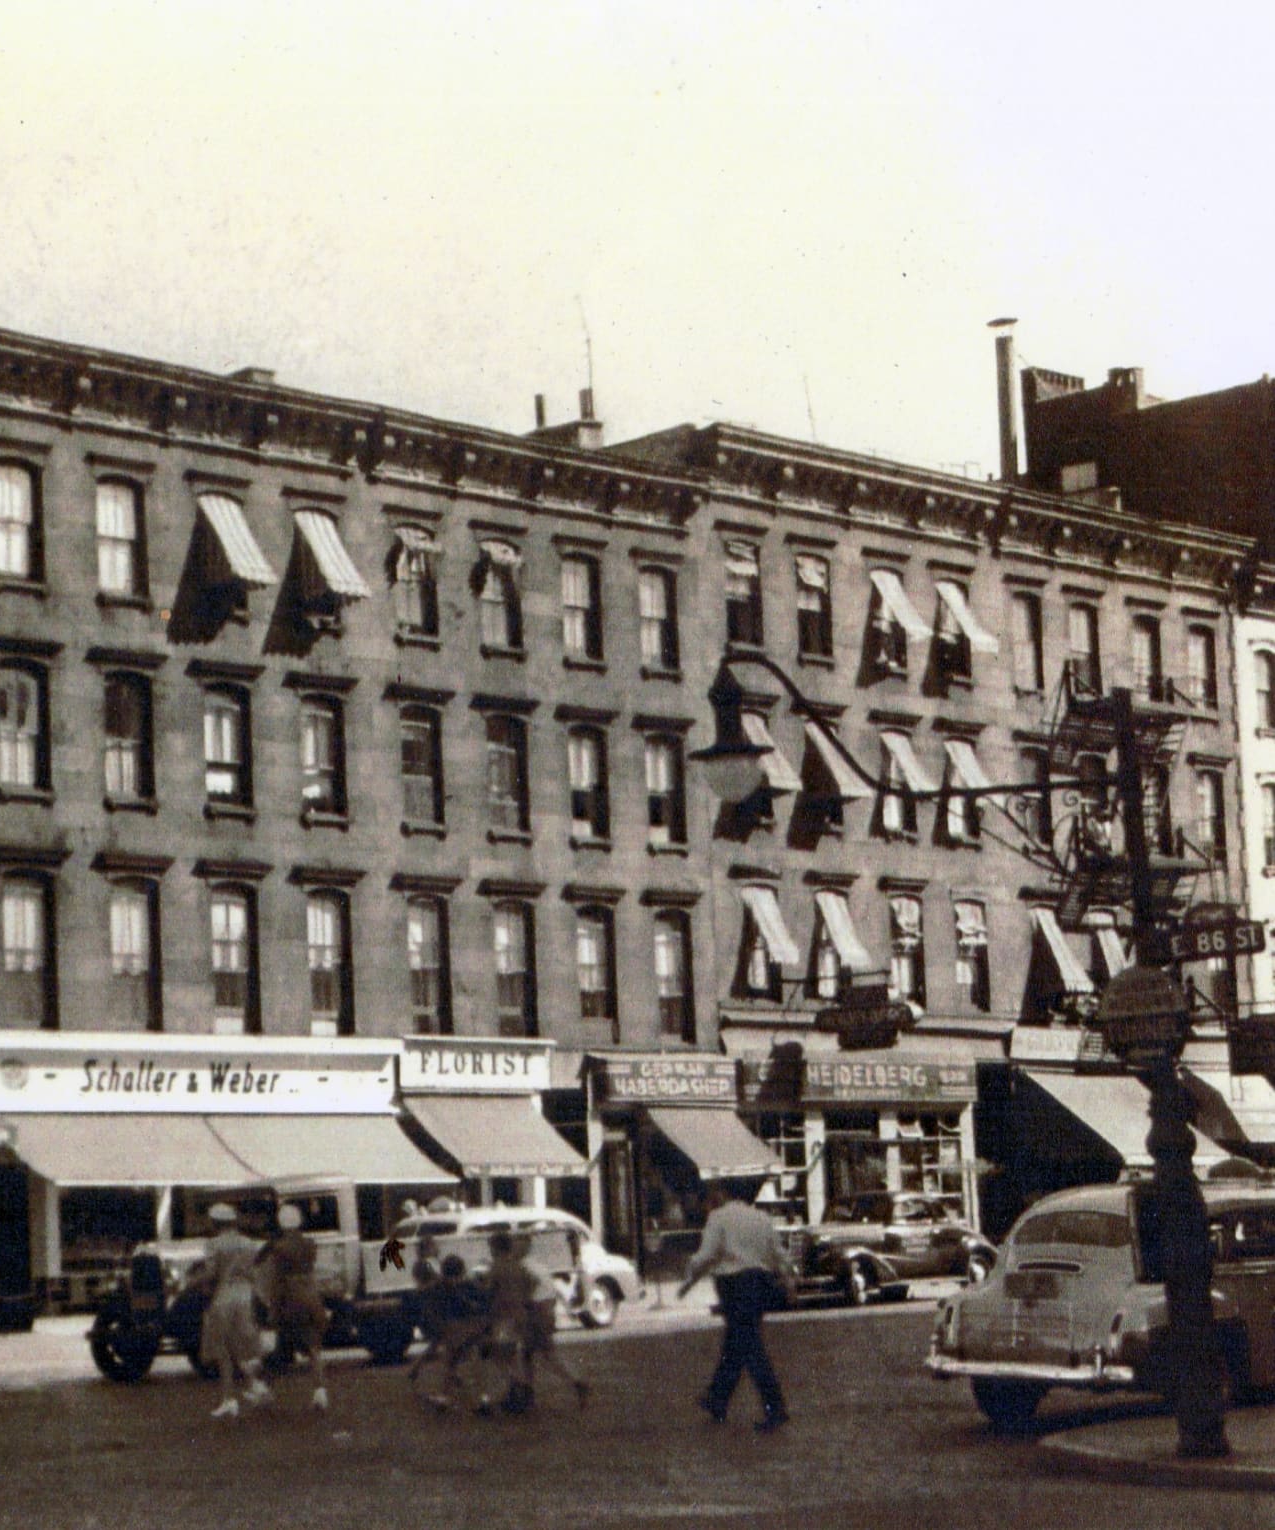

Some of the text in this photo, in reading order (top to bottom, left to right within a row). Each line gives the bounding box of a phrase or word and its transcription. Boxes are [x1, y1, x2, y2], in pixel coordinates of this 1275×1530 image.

[1171, 924, 1258, 956] E 86 ST
[419, 1049, 532, 1075] FLORIST
[80, 1058, 280, 1093] Schaller & Weber
[614, 1077, 730, 1097] HABERDASHER
[806, 1064, 928, 1087] HEIDELBERG
